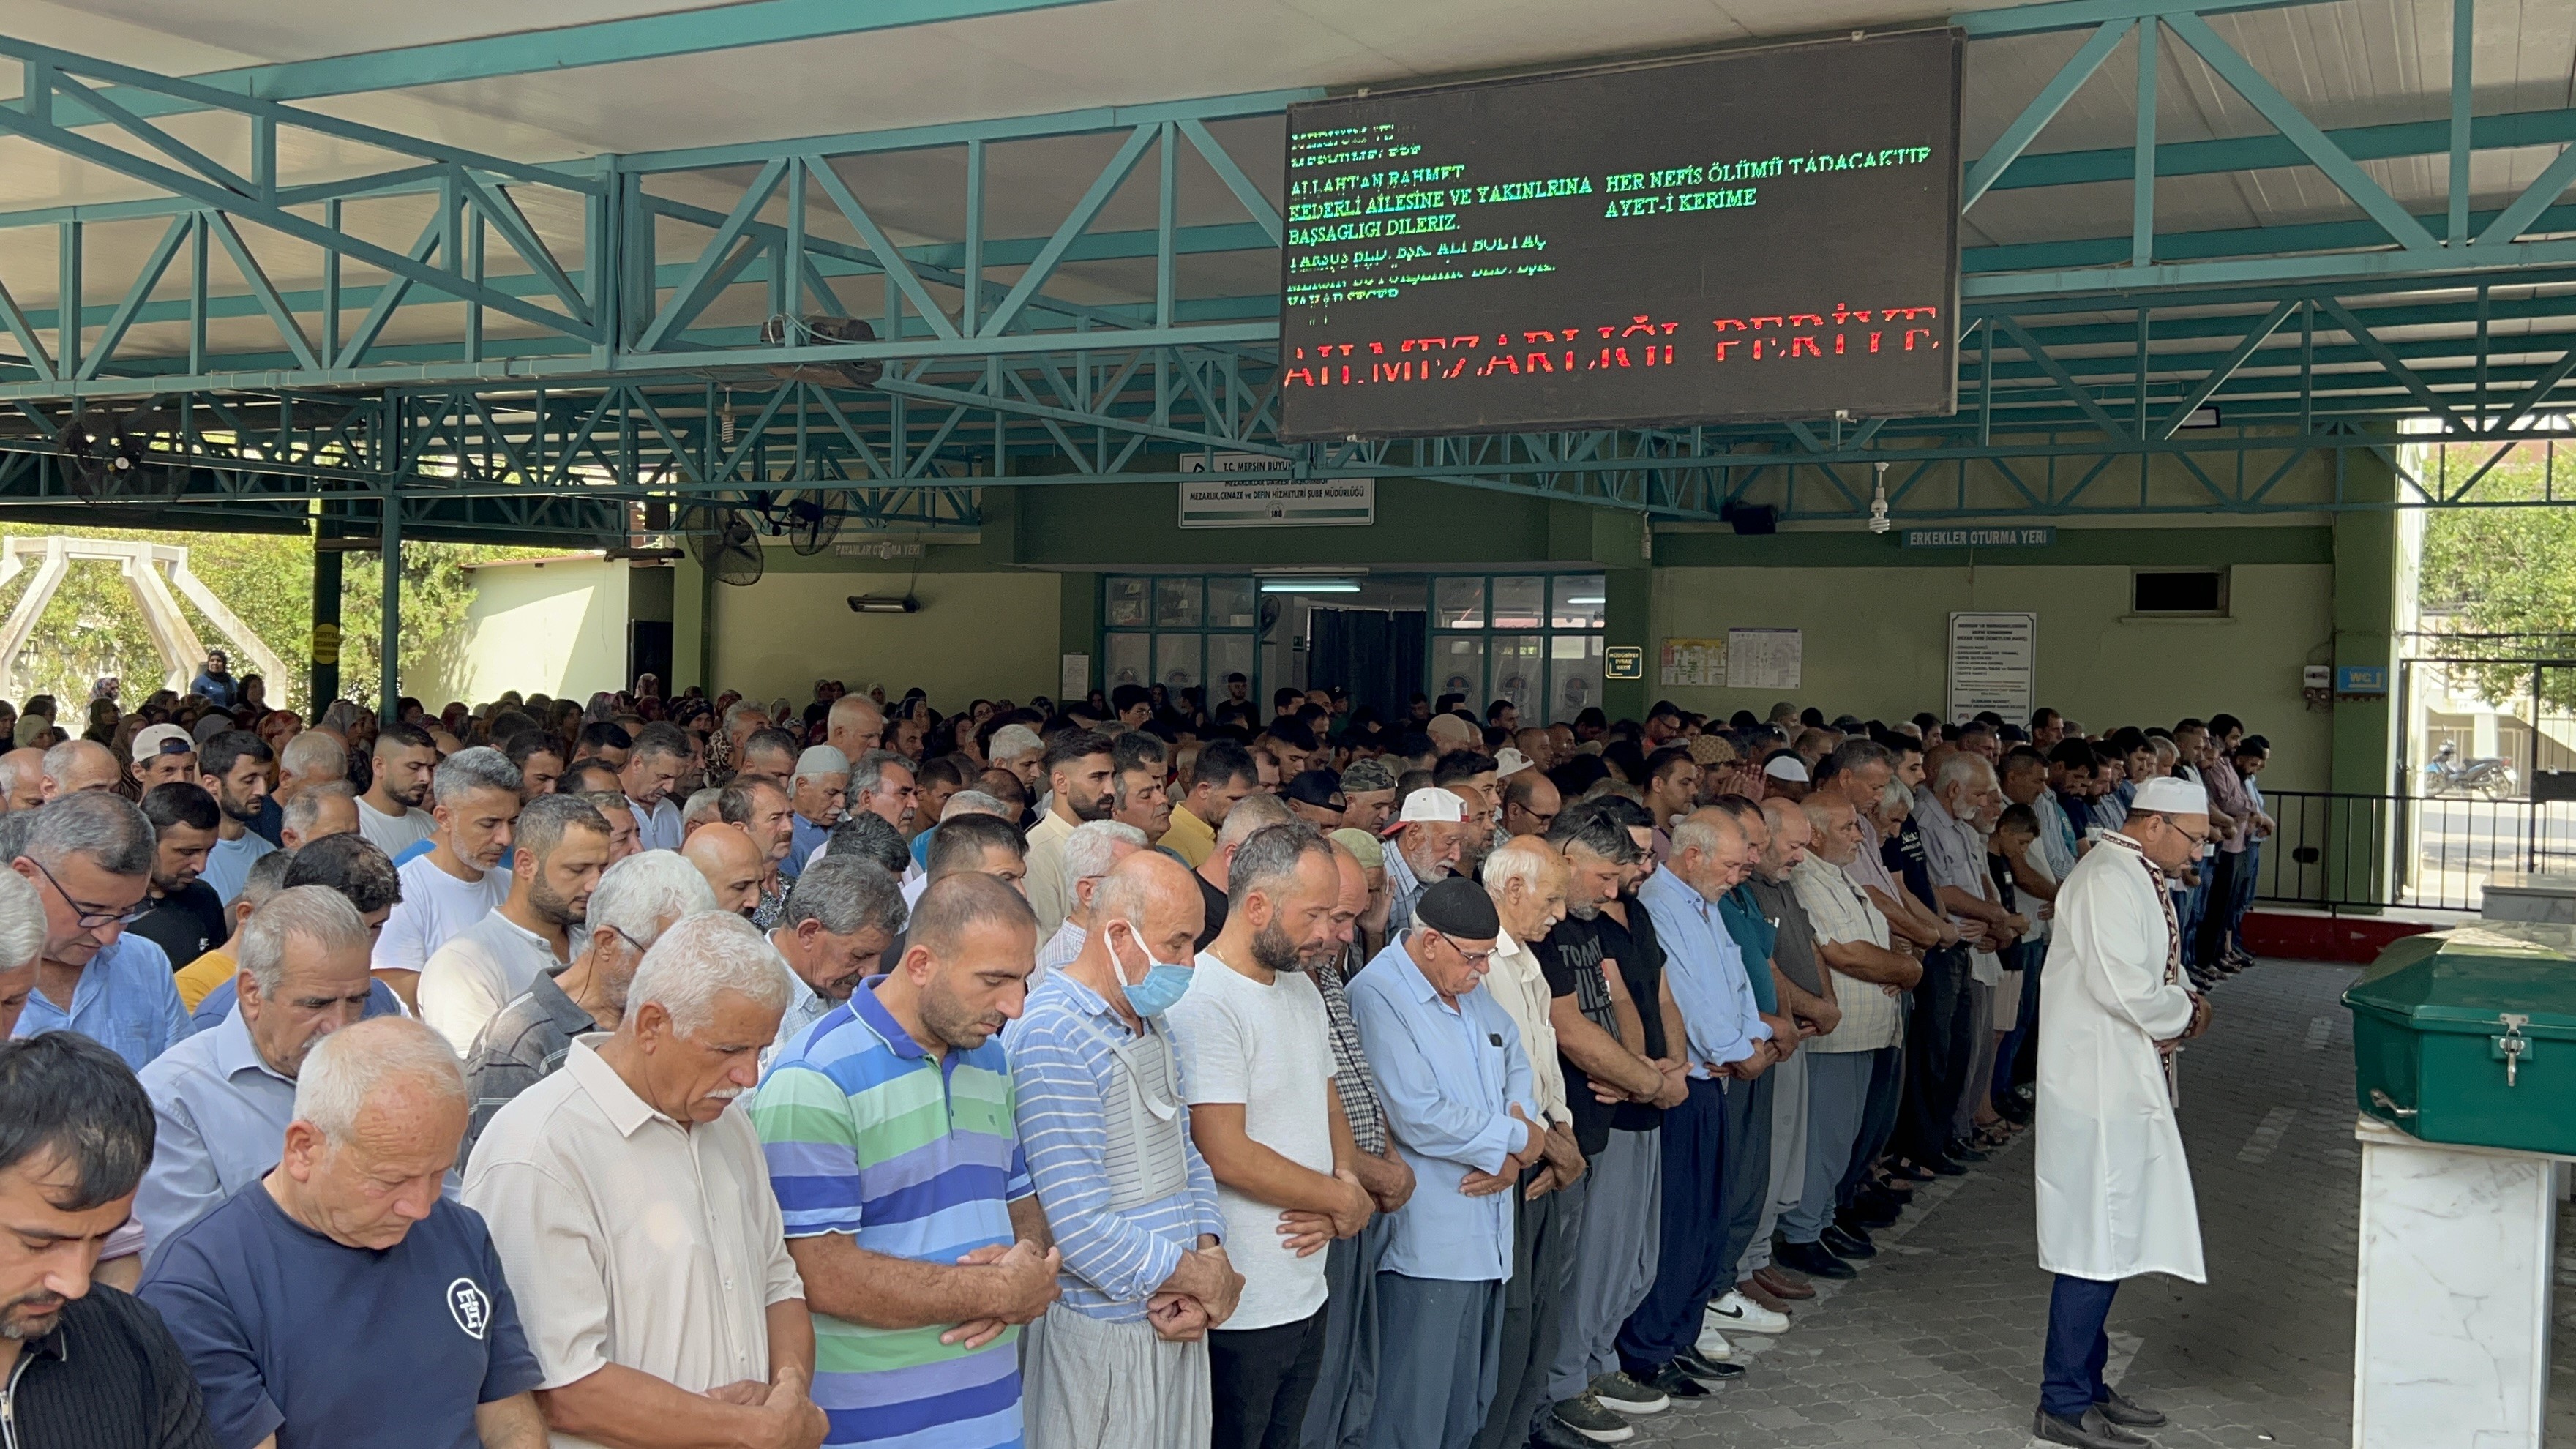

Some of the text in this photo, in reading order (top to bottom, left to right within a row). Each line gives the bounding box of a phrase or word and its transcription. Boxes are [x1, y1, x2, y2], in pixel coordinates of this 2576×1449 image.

[1606, 171, 1645, 192] HER
[1649, 165, 1704, 188] NEFİS
[1708, 157, 1784, 183] ÖLÜMÜ
[1366, 189, 1445, 214] AİLESİNE
[1448, 188, 1472, 206] VE
[1678, 187, 1757, 212] KERİME
[1253, 488, 1270, 499] DEFİN
[1272, 488, 1306, 498] HİZMETLERİ
[1308, 489, 1322, 500] ŞUBE
[1324, 486, 1364, 498] MÜDÜRLÜĞÜ
[1910, 531, 1966, 545] ERKEKLER
[1970, 530, 2017, 544] OTURMA
[2350, 672, 2371, 682] WC
